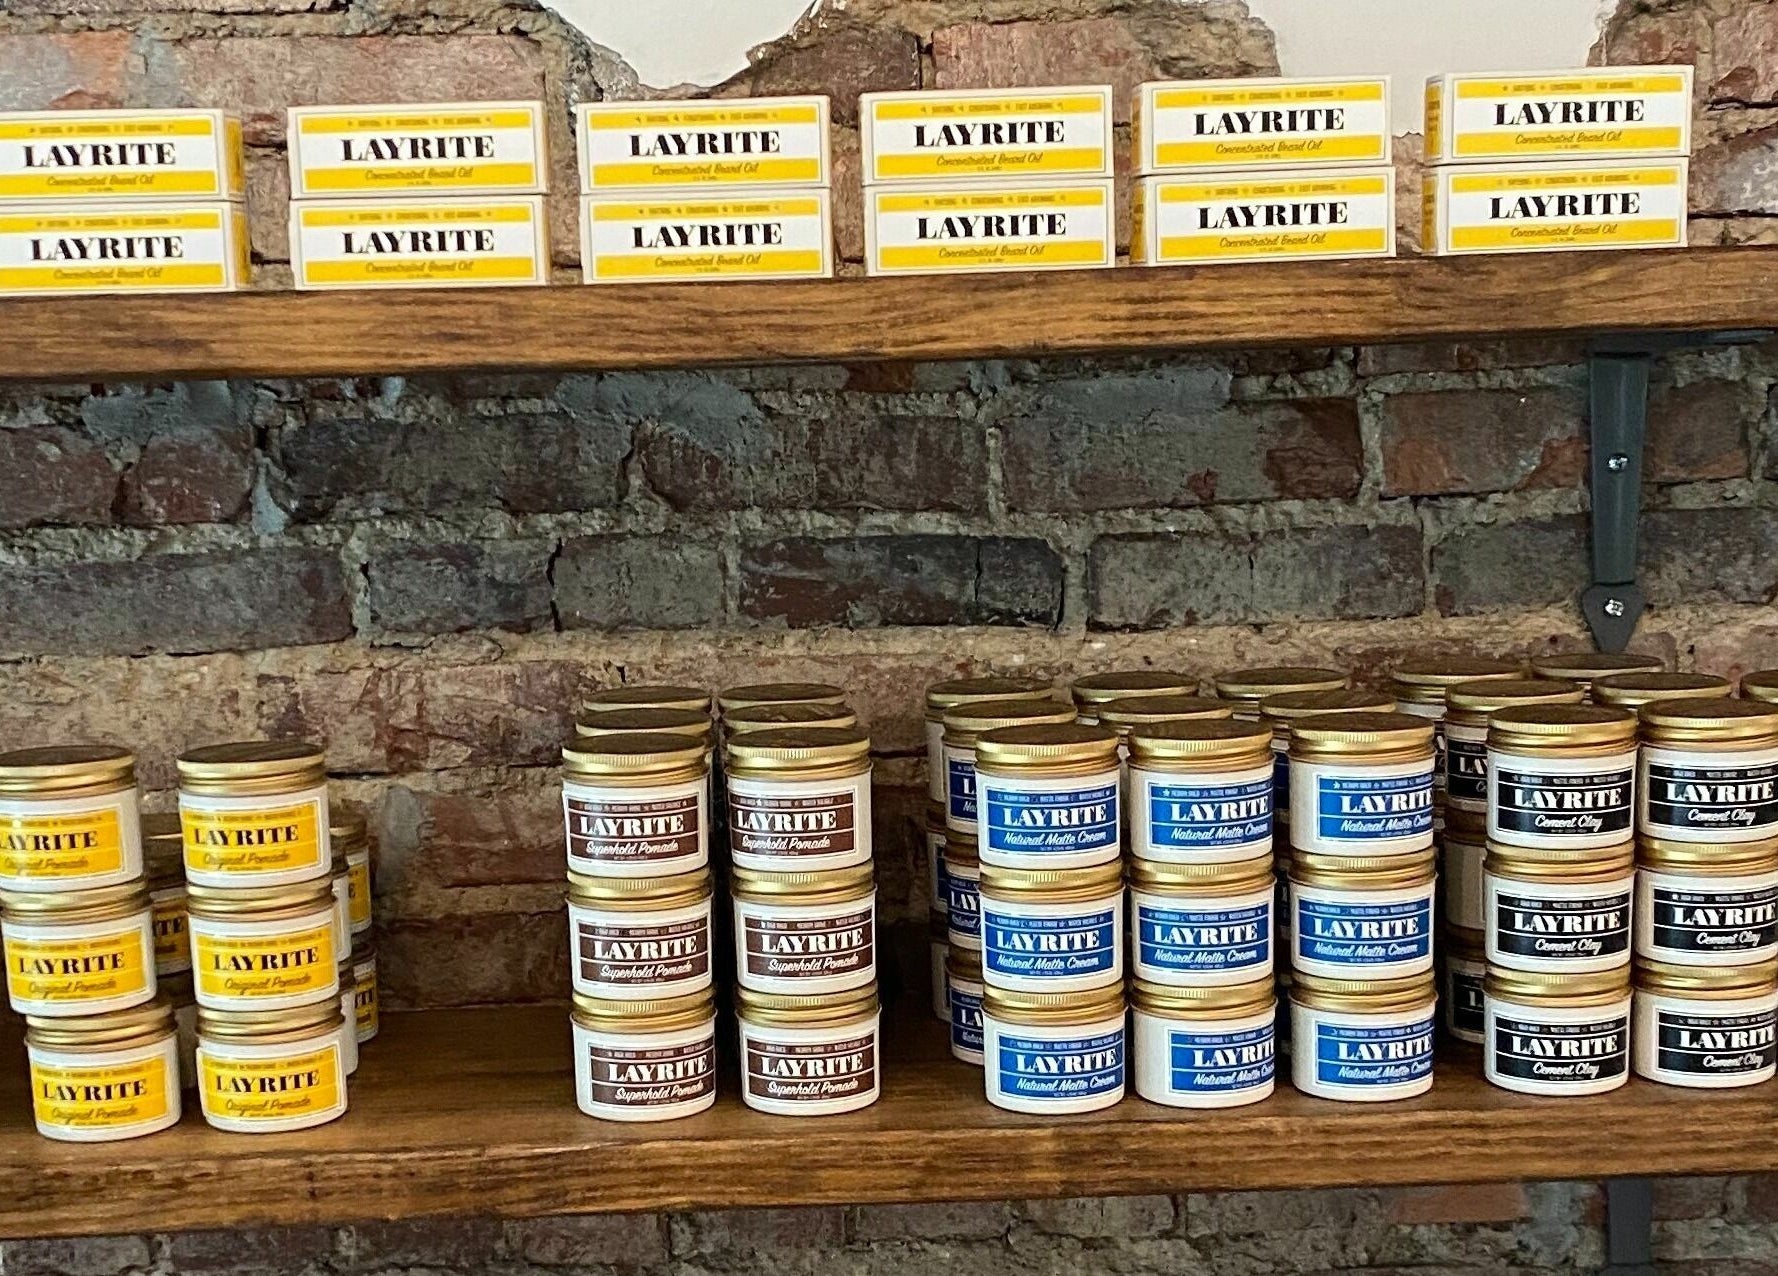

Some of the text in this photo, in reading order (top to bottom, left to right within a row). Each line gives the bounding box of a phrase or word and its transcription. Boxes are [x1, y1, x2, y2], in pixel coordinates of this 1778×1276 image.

[1193, 108, 1344, 136] LAYRITE
[1493, 99, 1644, 126] LAYRITE
[629, 130, 780, 157] LAYRITE
[913, 120, 1064, 147] LAYRITE
[23, 142, 176, 167] LAYRITE
[341, 135, 494, 161] LAYRITE
[1197, 202, 1348, 230] LAYRITE
[1489, 192, 1640, 219] LAYRITE
[632, 222, 782, 248] LAYRITE
[916, 213, 1066, 240] LAYRITE
[30, 236, 183, 261] LAYRITE
[342, 229, 494, 254] LAYRITE
[1340, 788, 1432, 813] LAYRITE
[1514, 788, 1622, 808] LAYRITE
[1666, 781, 1774, 802] LAYRITE
[1003, 804, 1107, 827] LAYRITE
[1171, 796, 1268, 821] LAYRITE
[1688, 809, 1756, 825] Cement Clay
[580, 815, 684, 836] LAYRITE
[737, 810, 837, 831] LAYRITE
[1341, 819, 1385, 832] Natural
[1385, 818, 1412, 830] Matte
[1535, 815, 1603, 832] Cement Clay
[194, 824, 299, 846] LAYRITE
[742, 835, 830, 850] Superhold Pomade
[1004, 830, 1106, 845] Natural Matte Cream
[1171, 828, 1214, 839] Natural
[1215, 827, 1243, 839] Matte
[586, 840, 679, 855] Superhold Pomade
[1514, 912, 1620, 932] LAYRITE
[1673, 903, 1775, 926] LAYRITE
[1154, 922, 1258, 945] LAYRITE
[1314, 917, 1419, 939] LAYRITE
[1697, 931, 1761, 947] Cement Clay
[594, 935, 697, 960] LAYRITE
[761, 928, 863, 953] LAYRITE
[996, 930, 1100, 951] LAYRITE
[1314, 942, 1418, 957] Natural Matte Cream
[1535, 939, 1602, 955] Cement Clay
[19, 951, 125, 975] LAYRITE
[213, 947, 319, 971] LAYRITE
[768, 955, 859, 972] Superhold Pomade
[997, 954, 1099, 970] Natural Matte Cream
[1155, 949, 1257, 963] Natural Matte Cream
[601, 960, 693, 978] Superhold Pomade
[272, 974, 312, 988] Pomade
[1338, 1034, 1432, 1060] LAYRITE
[1512, 1035, 1617, 1057] LAYRITE
[608, 1055, 707, 1082] LAYRITE
[761, 1053, 863, 1076] LAYRITE
[1017, 1049, 1116, 1073] LAYRITE
[1338, 1066, 1382, 1078] Natural
[1382, 1065, 1409, 1077] Matte
[1533, 1062, 1599, 1078] Cement Clay
[1703, 1053, 1763, 1068] Cement Clay
[216, 1070, 320, 1093] LAYRITE
[768, 1078, 859, 1094] Superhold Pomade
[1017, 1075, 1115, 1091] Natural Matte Cream
[1194, 1073, 1237, 1086] Natural
[1237, 1070, 1260, 1082] Matte
[42, 1079, 147, 1101] LAYRITE
[615, 1080, 704, 1100] Superhold Pomade
[270, 1097, 311, 1110] Pomade
